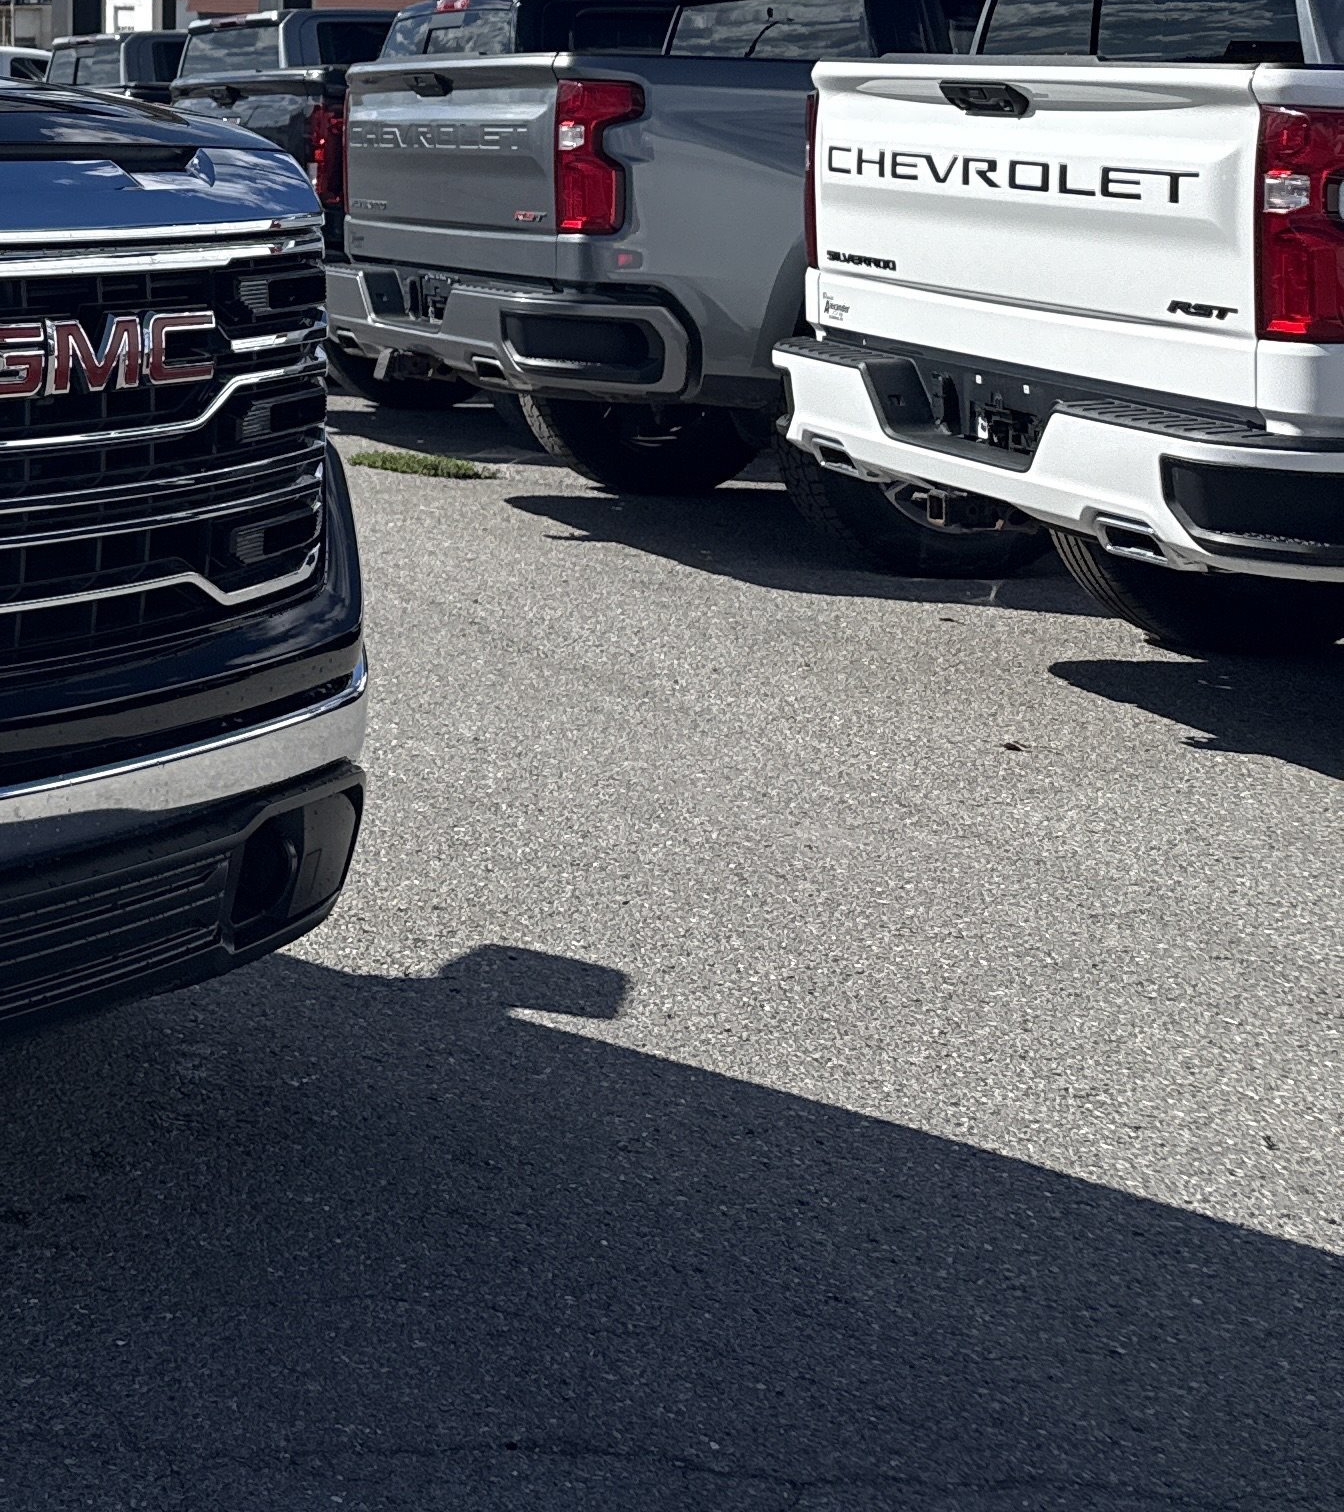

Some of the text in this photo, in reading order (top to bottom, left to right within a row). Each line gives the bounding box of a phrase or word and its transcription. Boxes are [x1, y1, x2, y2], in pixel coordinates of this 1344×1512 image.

[349, 123, 530, 151] CHEVROLET
[826, 145, 1201, 204] CHEVROLET
[1166, 299, 1239, 322] RST
